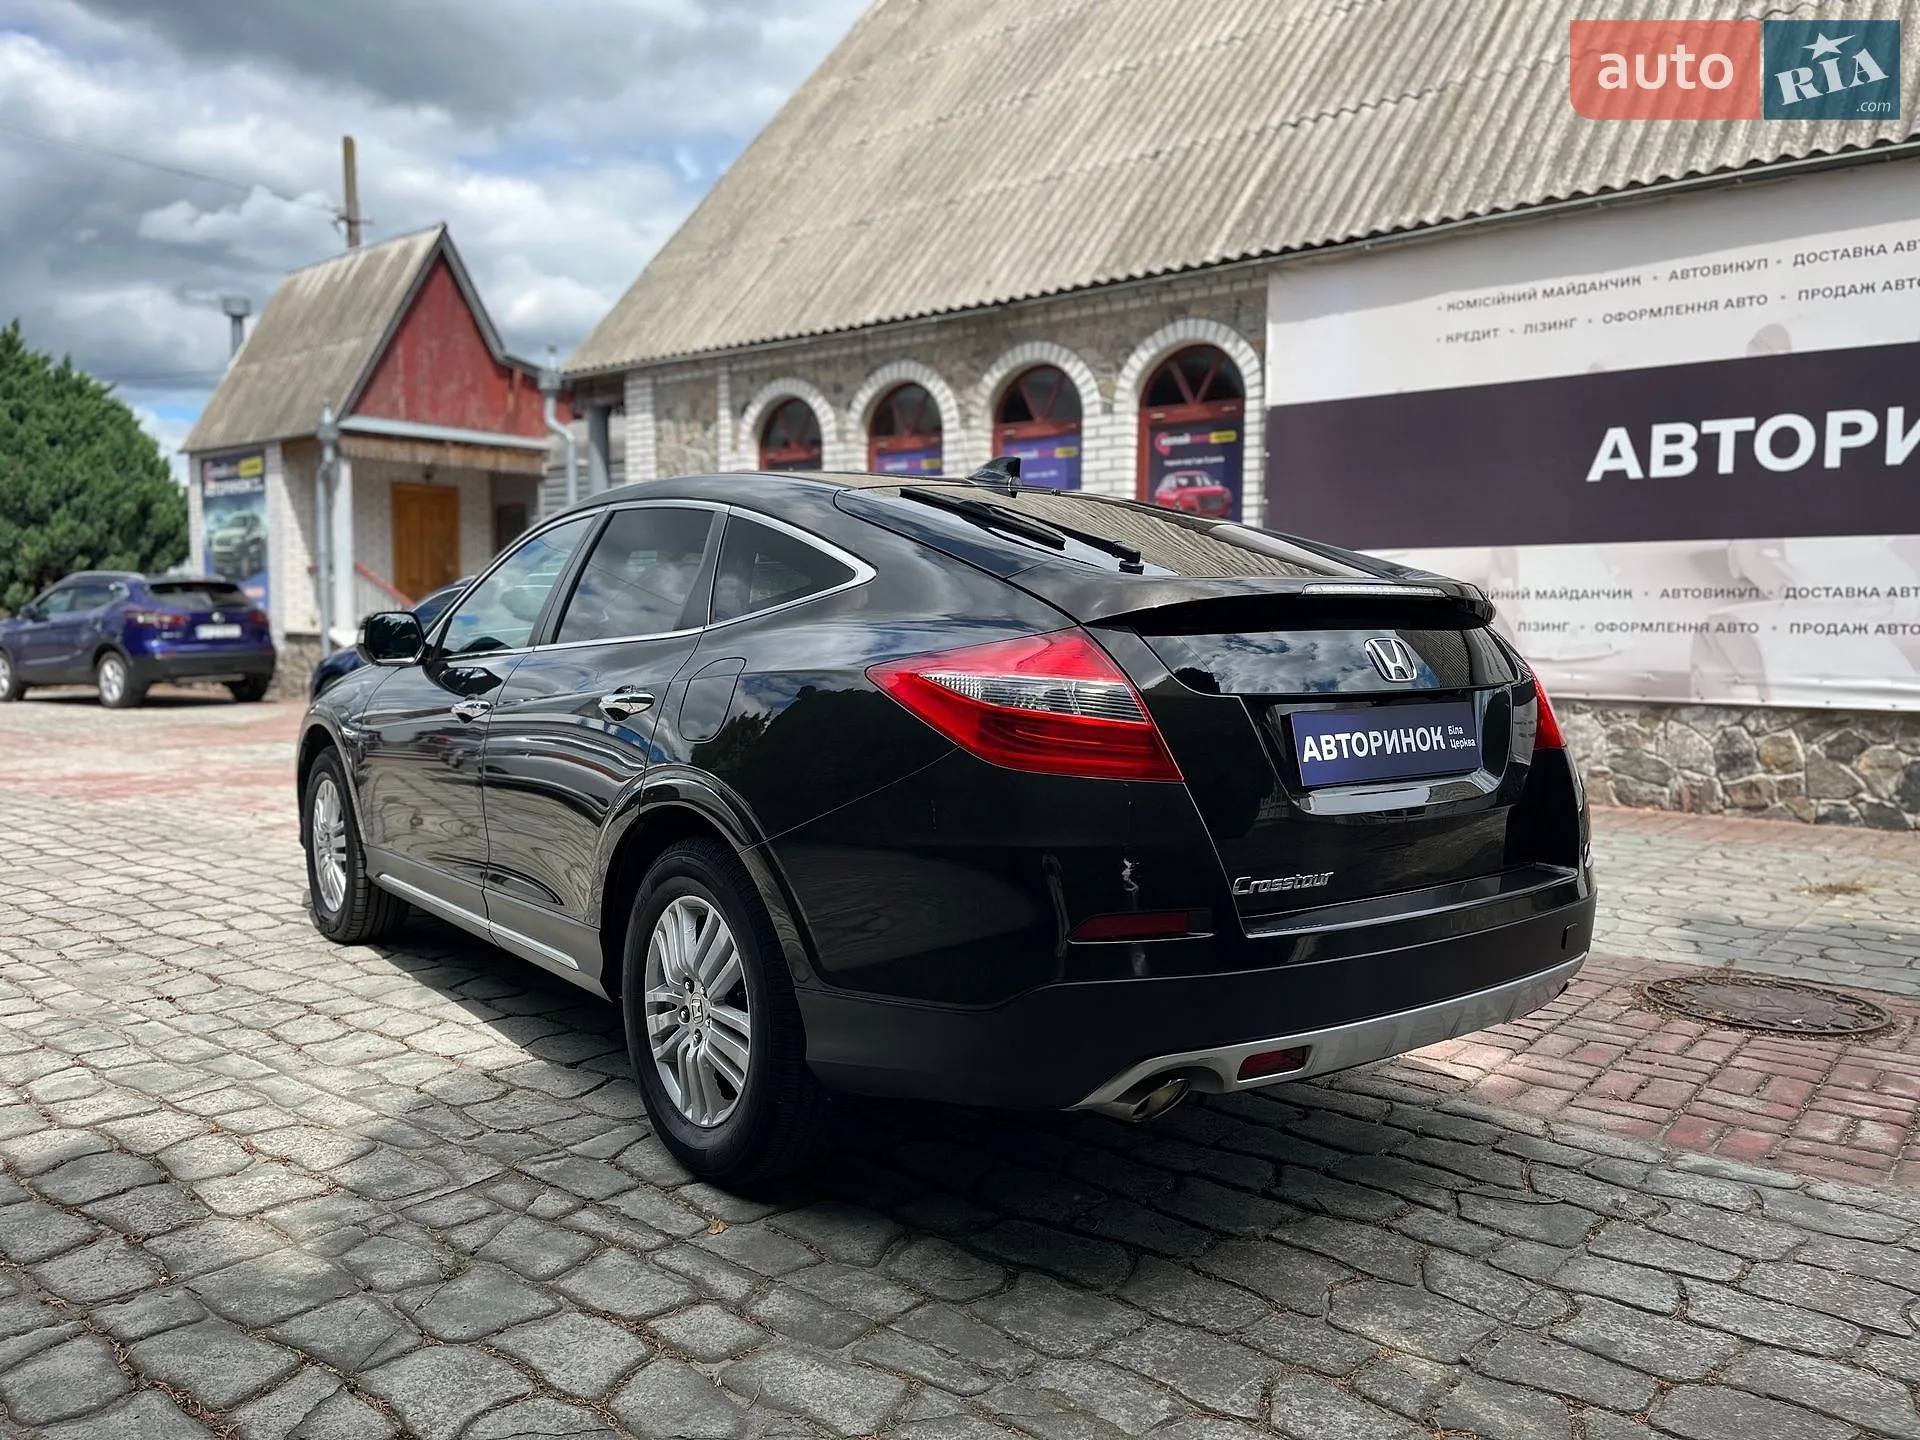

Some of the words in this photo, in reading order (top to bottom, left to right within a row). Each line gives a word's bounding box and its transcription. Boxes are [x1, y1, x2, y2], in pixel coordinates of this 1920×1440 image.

[1446, 287, 1538, 313] КОМІСІЙНИЙ
[1542, 274, 1642, 299] МАЙДАНЧИК
[1668, 257, 1768, 282] АВТОВИКУП
[1793, 243, 1888, 268] ДОСТАВКА
[1893, 238, 1920, 254] АВ
[1446, 327, 1501, 344] КРЕДИТ
[1523, 317, 1577, 335] ЛІЗИНГ
[1602, 299, 1719, 325] ОФОРМЛЕННЯ
[1723, 293, 1768, 310] АВТО
[1798, 281, 1876, 301] ПРОДАЖ
[1882, 277, 1920, 292] АВТ
[1535, 587, 1633, 602] МАЙДАНЧИК
[1659, 586, 1760, 600] АВТОВИКУП
[1784, 586, 1881, 600] ДОСТАВКА
[1517, 621, 1570, 633] ЛІЗИНГ
[1594, 621, 1709, 635] ОФОРМЛЕННЯ
[1715, 622, 1760, 635] АВТО
[1789, 622, 1868, 637] ПРОДАЖ
[1874, 623, 1920, 636] АВТО
[1447, 725, 1464, 735] Біла
[1303, 726, 1446, 763] АВТОРИНОК
[1449, 737, 1476, 750] Церква
[1233, 871, 1335, 896] Crosstour
